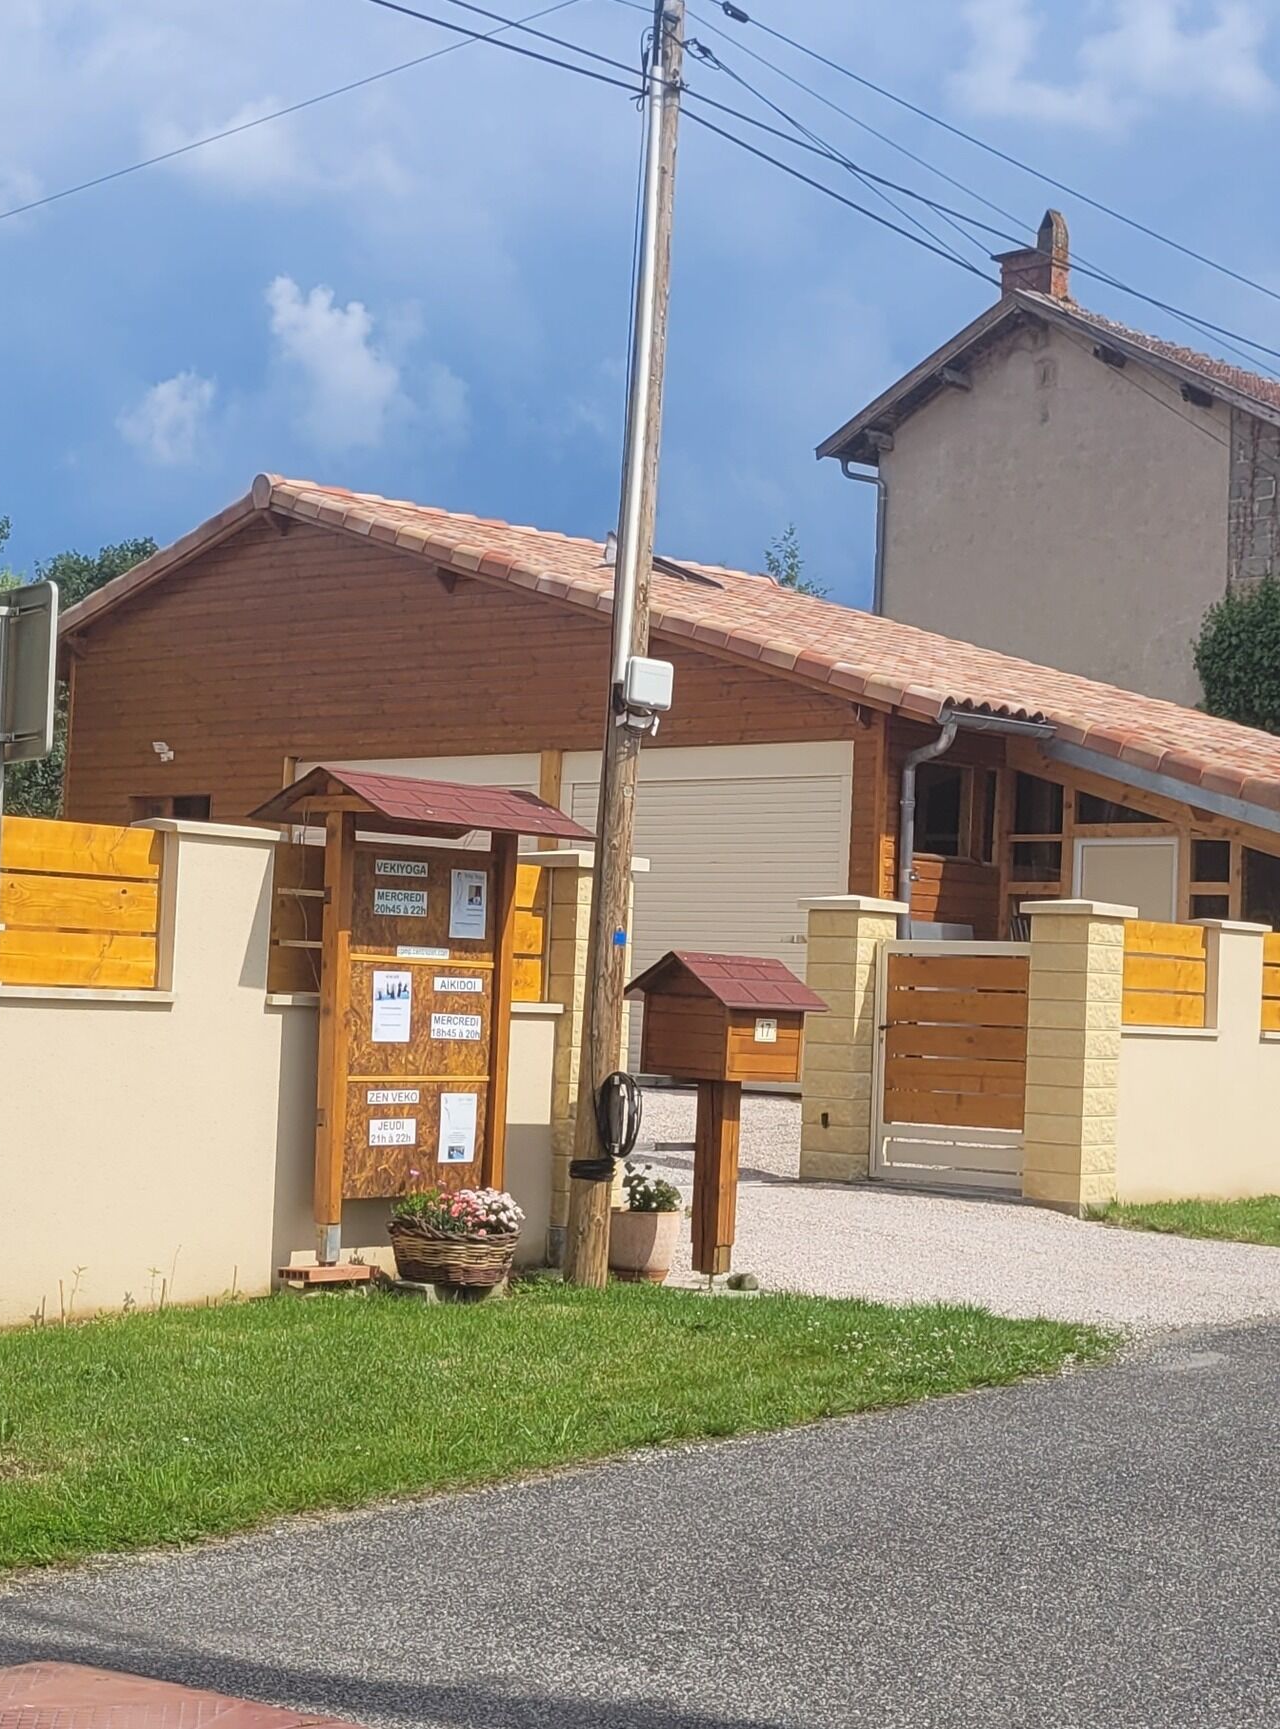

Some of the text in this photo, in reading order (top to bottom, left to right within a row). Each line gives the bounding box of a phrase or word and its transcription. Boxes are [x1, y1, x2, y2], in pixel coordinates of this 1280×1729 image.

[376, 862, 427, 875] VEKIYOGA
[377, 891, 425, 902] MERCREDI
[375, 903, 401, 914] 20h45
[410, 905, 426, 915] 22h
[433, 1015, 479, 1027] MERCREDI
[432, 1028, 457, 1038] 18h45
[466, 1029, 480, 1039] 20h
[761, 1023, 771, 1037] 17
[368, 1091, 418, 1103] ZEN VEKO
[377, 1120, 404, 1131] JEUDI
[371, 1134, 387, 1144] 21h
[395, 1133, 411, 1143] 22h
